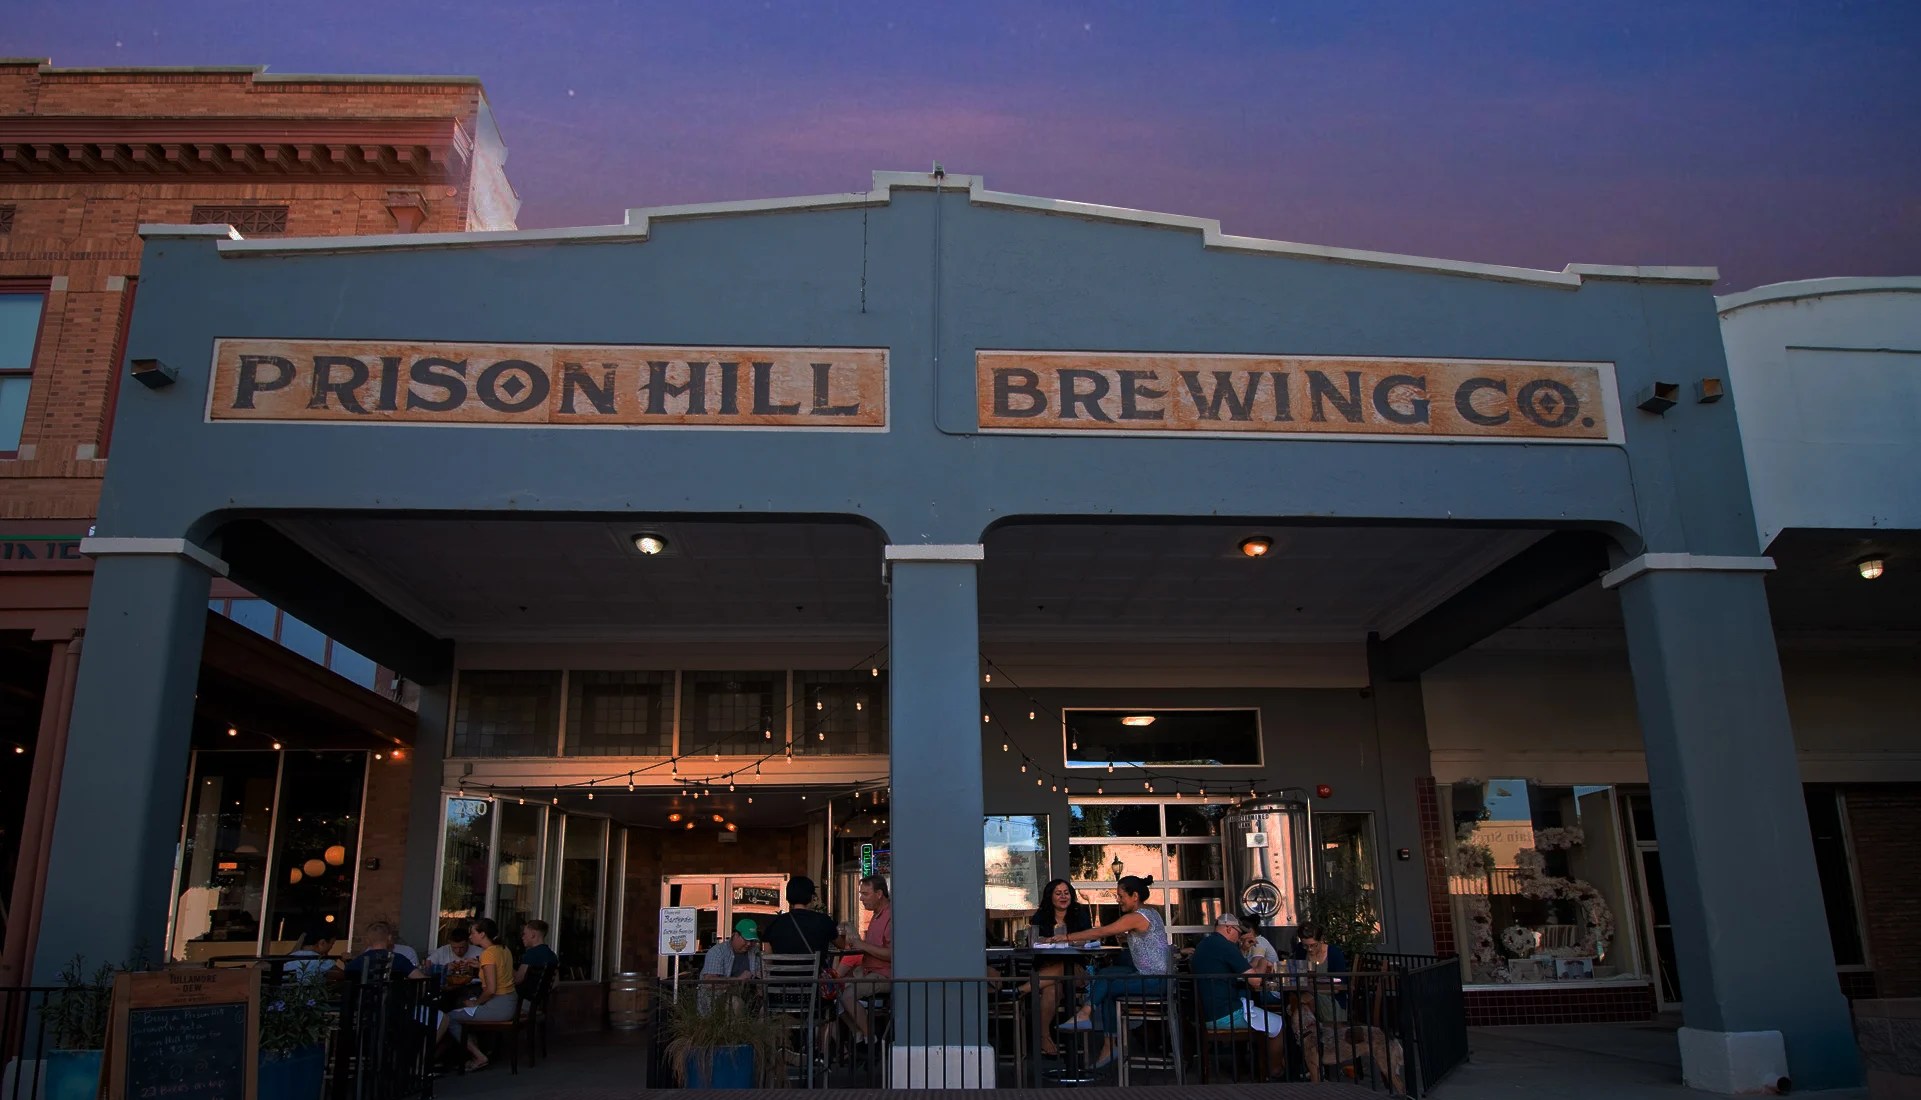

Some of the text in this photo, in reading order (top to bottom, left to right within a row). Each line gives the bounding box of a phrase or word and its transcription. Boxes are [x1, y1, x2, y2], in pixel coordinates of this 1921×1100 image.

[230, 354, 860, 416] PRISON HILL
[992, 366, 1596, 428] BREWING CO.
[168, 973, 217, 984] TULLAMORE
